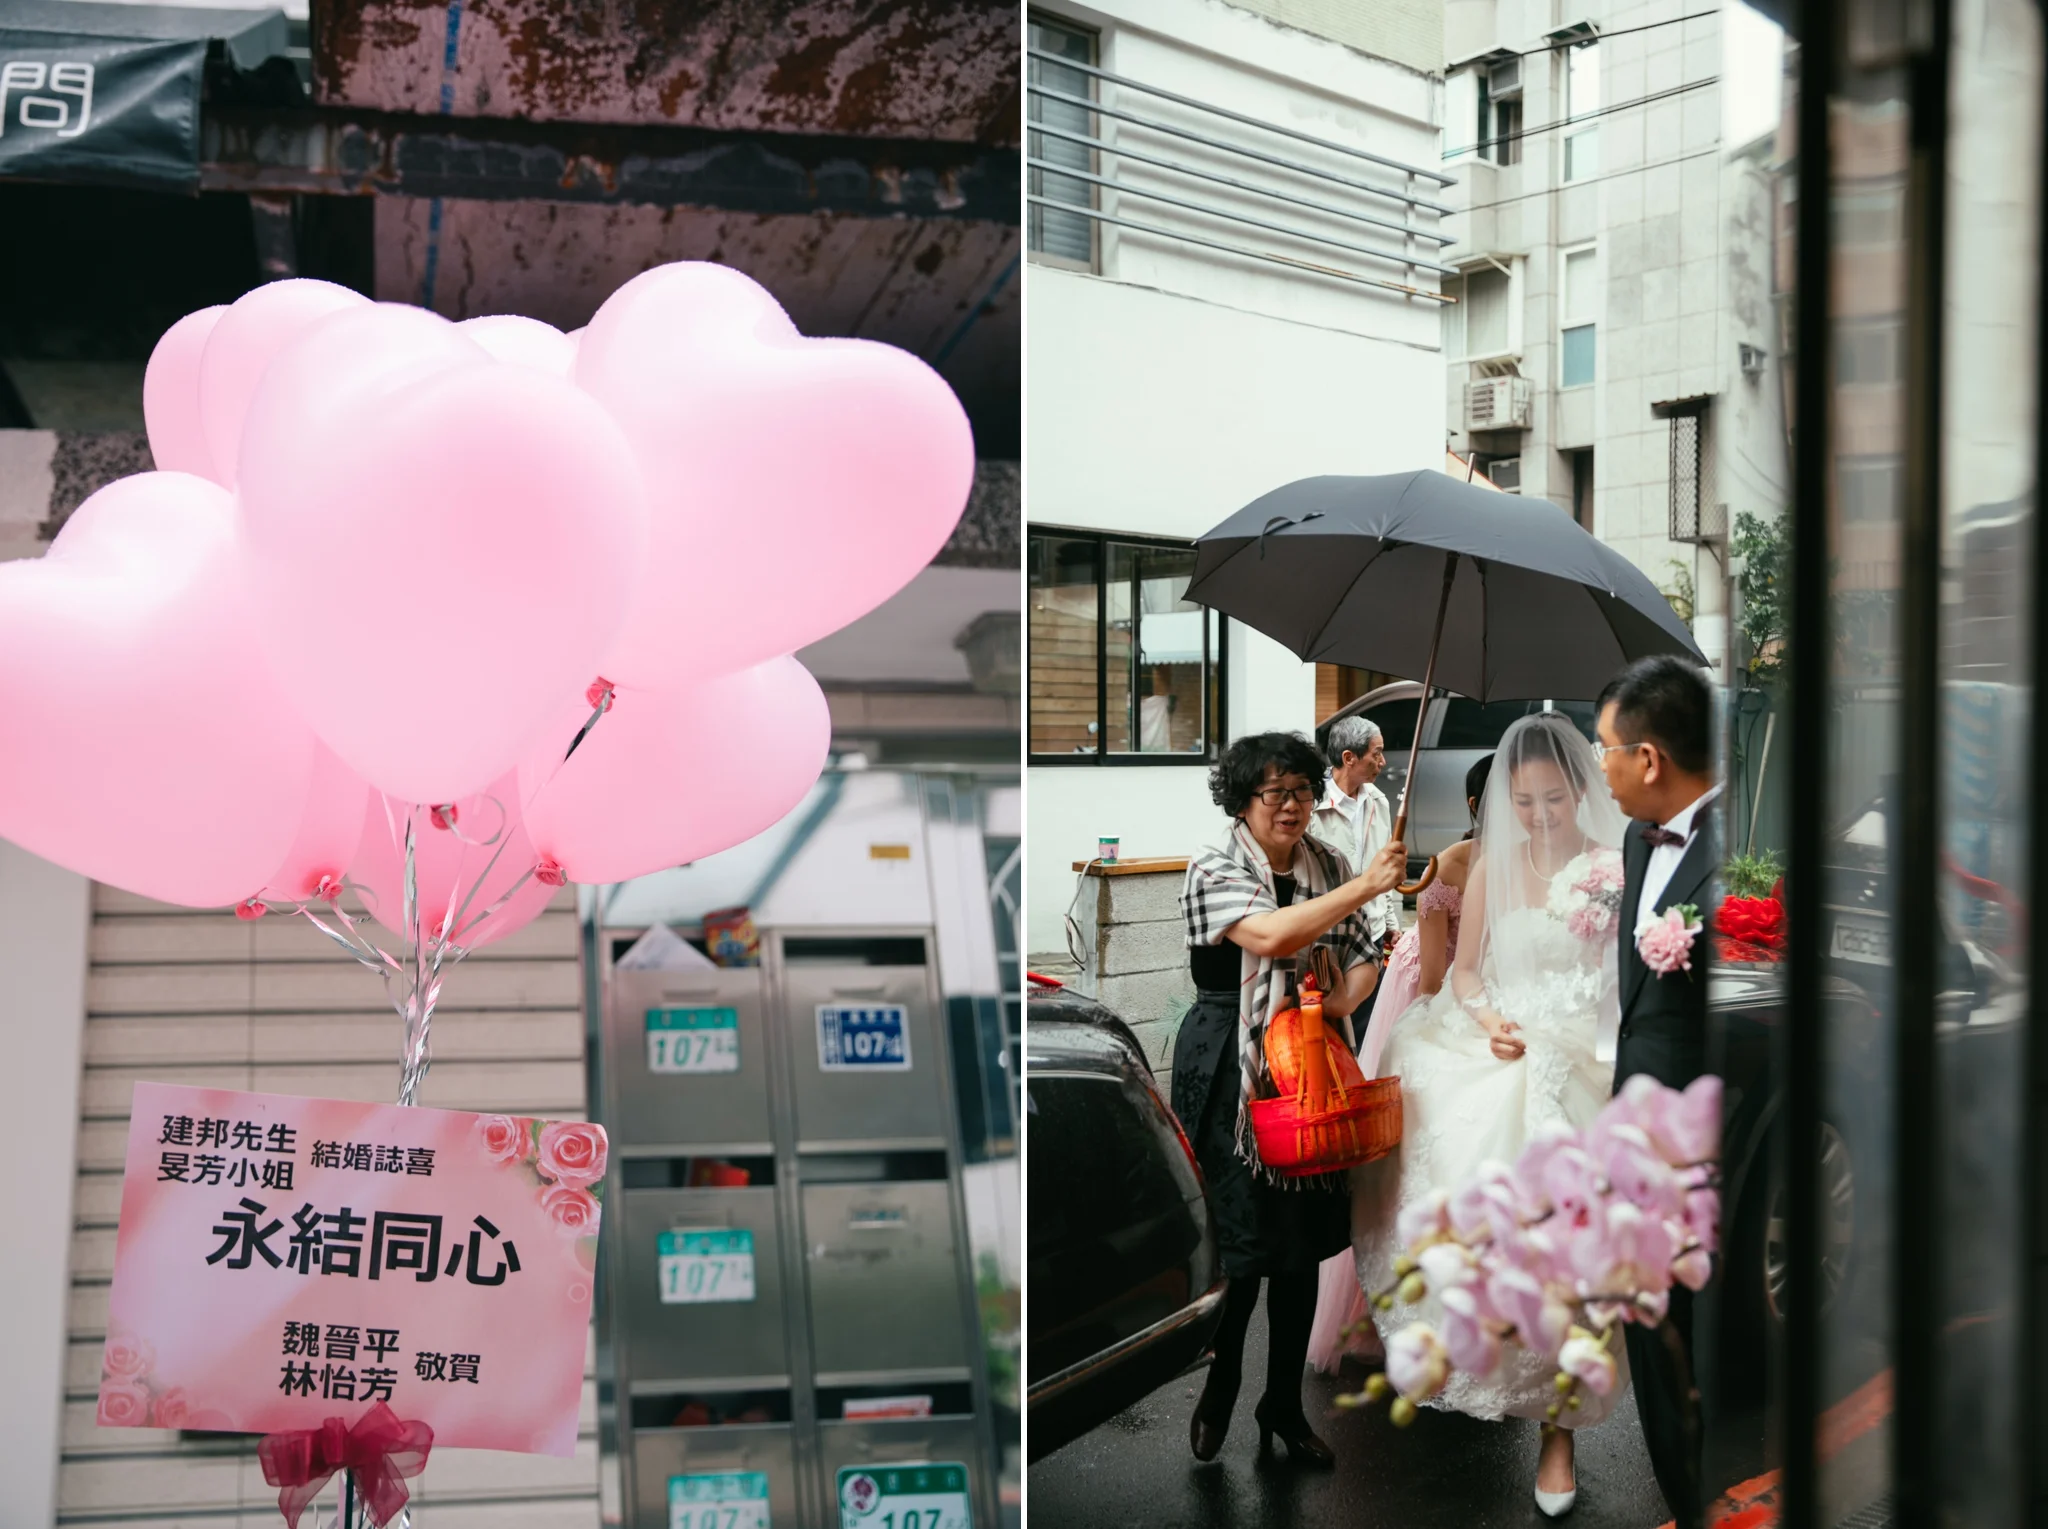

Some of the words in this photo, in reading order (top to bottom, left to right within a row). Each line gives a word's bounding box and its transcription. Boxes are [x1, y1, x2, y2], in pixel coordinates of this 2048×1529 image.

[656, 1035, 711, 1067] 107
[844, 1031, 885, 1058] 107
[160, 1115, 297, 1154] 建邦先生
[157, 1152, 294, 1190] 旻芳小姐
[311, 1140, 436, 1176] 結婚誌喜
[206, 1197, 520, 1286] 永結同心
[668, 1261, 725, 1294] 107
[282, 1321, 400, 1363] 魏晉平
[279, 1361, 398, 1402] 林怡芳
[414, 1352, 480, 1384] 敬賀
